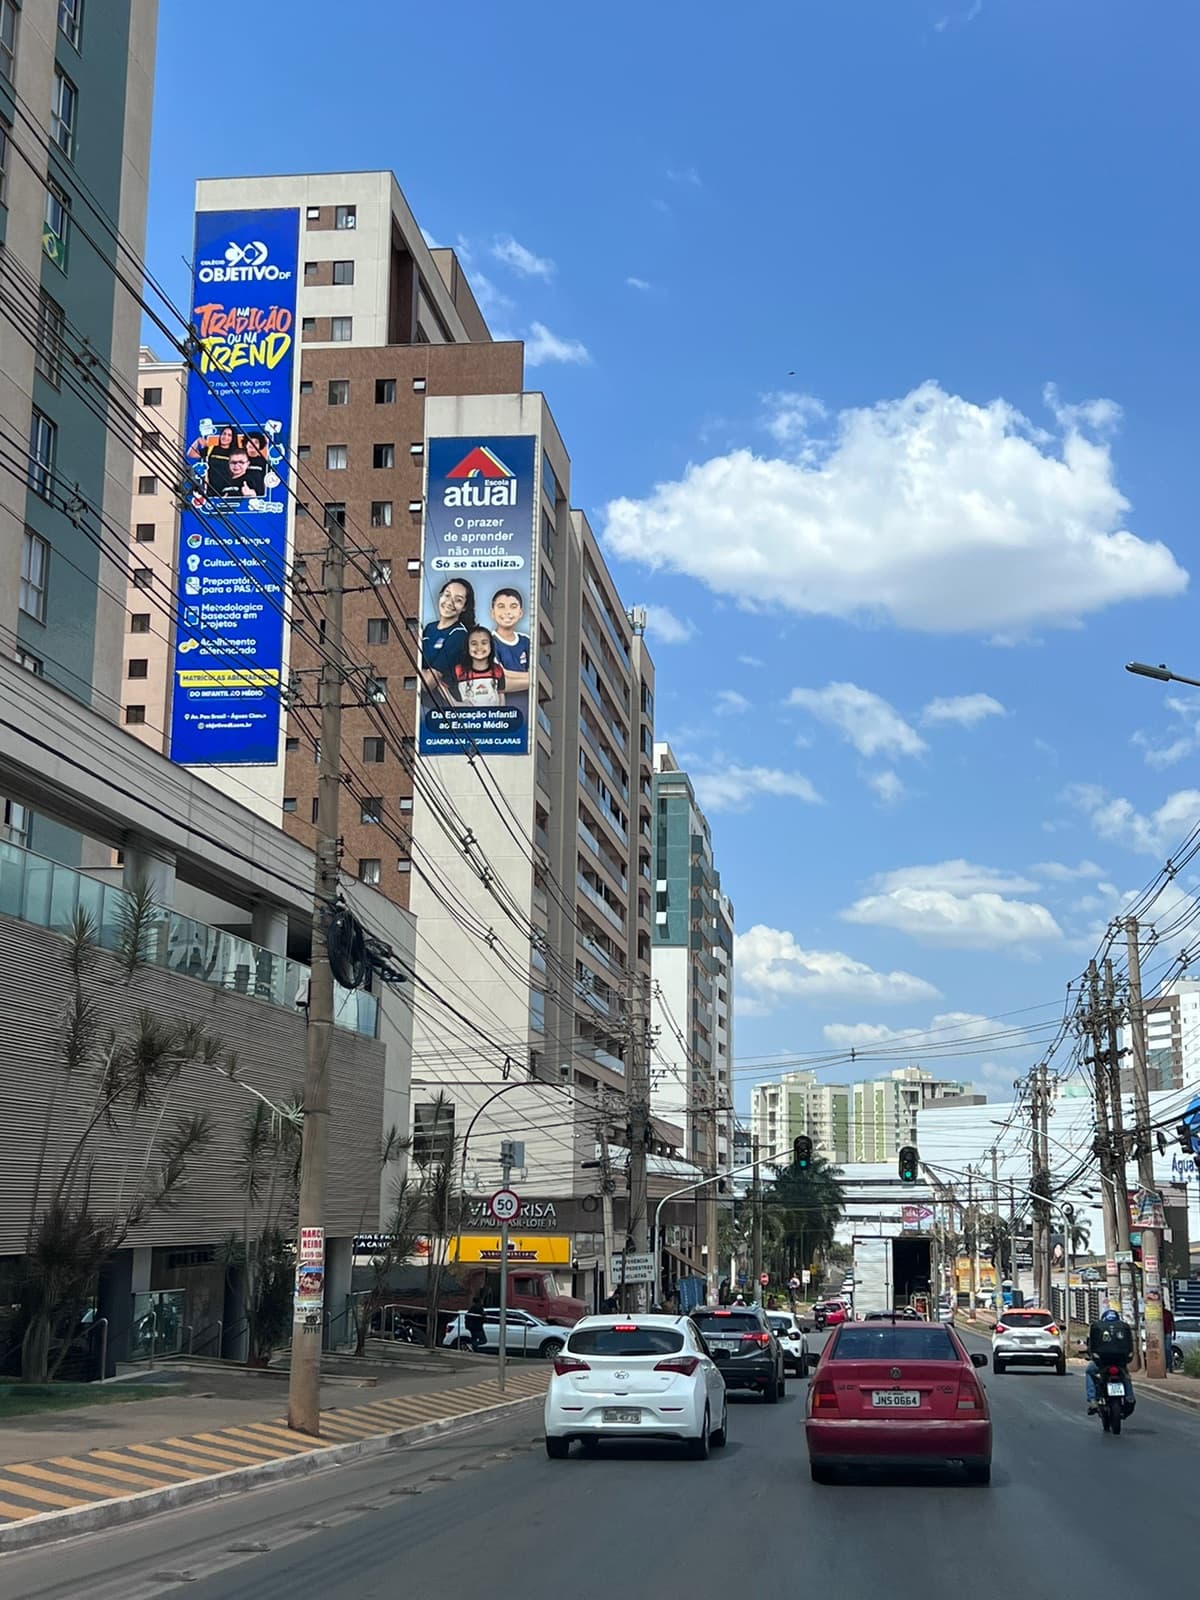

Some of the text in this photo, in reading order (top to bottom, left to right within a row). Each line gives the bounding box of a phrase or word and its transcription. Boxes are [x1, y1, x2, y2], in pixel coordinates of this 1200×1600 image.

[199, 265, 291, 283] OBJETIVO DF
[237, 307, 250, 318] NA
[194, 303, 292, 337] TRADIÇÃO
[227, 332, 257, 345] OU NA
[200, 332, 291, 374] TREND
[443, 479, 517, 507] atual
[454, 517, 504, 529] O prazer
[444, 531, 514, 543] de aprender
[447, 546, 469, 556] não
[435, 559, 450, 568] Só
[471, 559, 520, 568] atualiza.
[202, 587, 222, 595] para
[243, 612, 258, 620] em
[201, 621, 238, 630] projetos
[189, 690, 200, 698] DO
[431, 710, 517, 720] Da Educação Infantil
[483, 721, 509, 729] Médio
[1172, 1152, 1199, 1174] Água
[497, 1199, 514, 1211] 50
[874, 1396, 918, 1405] JNS 0664
